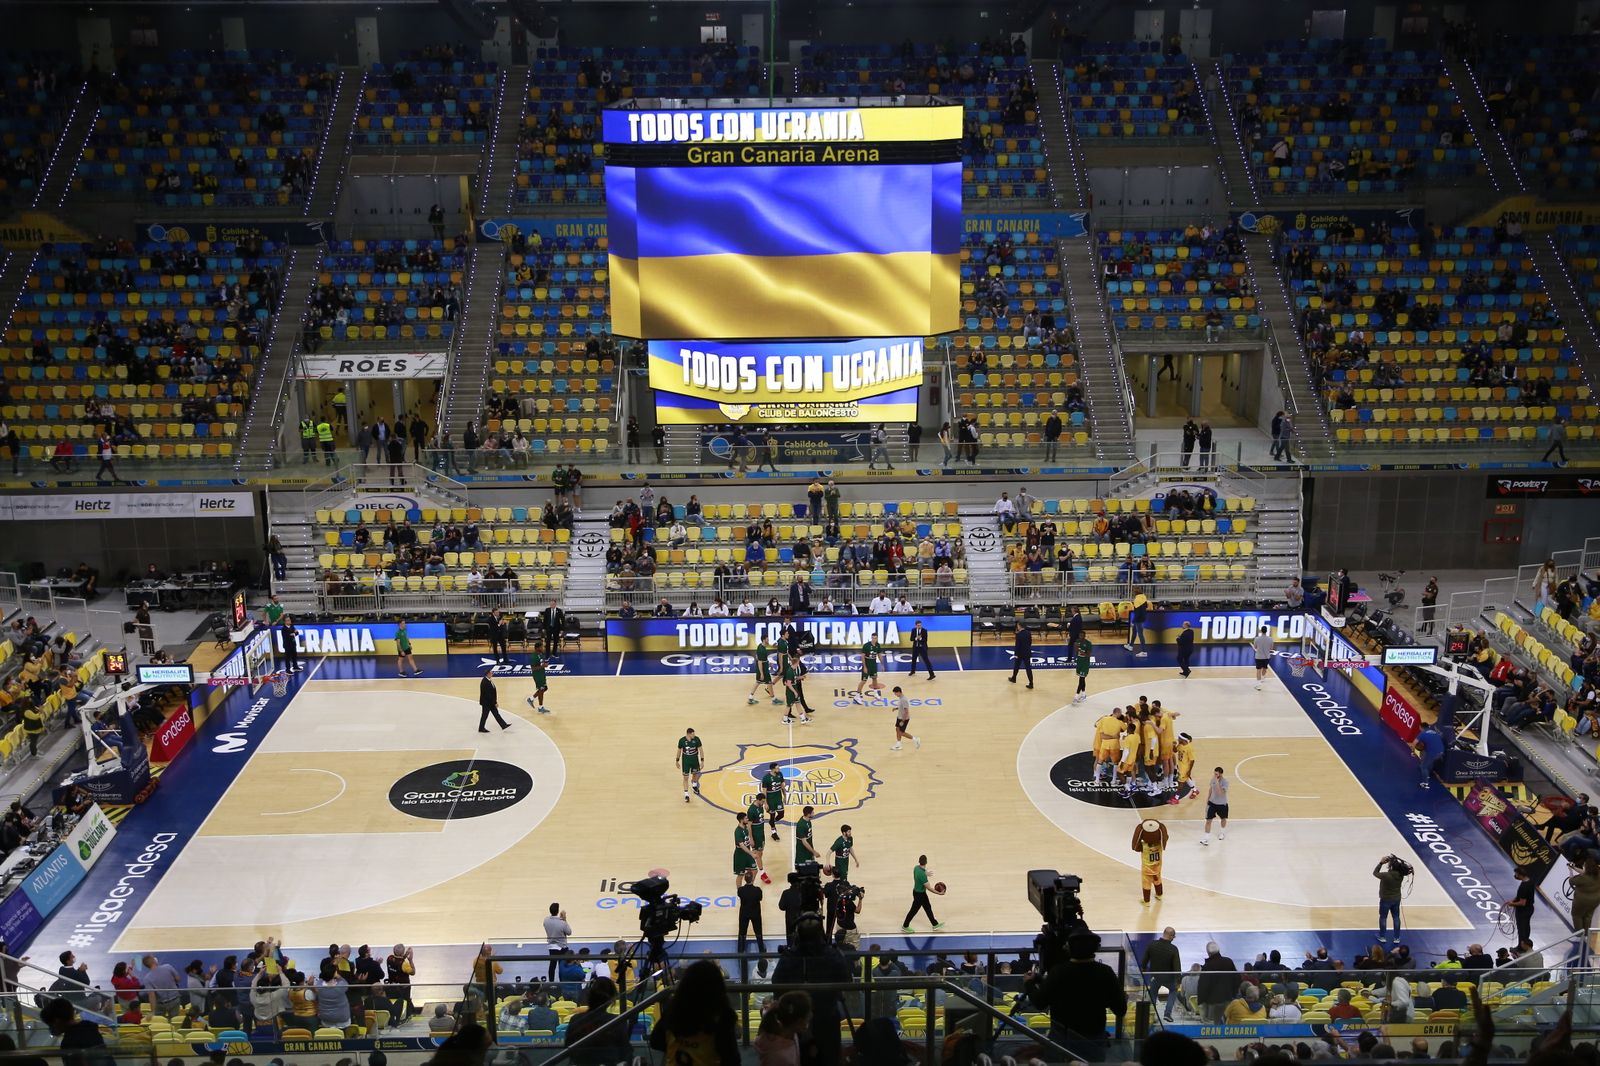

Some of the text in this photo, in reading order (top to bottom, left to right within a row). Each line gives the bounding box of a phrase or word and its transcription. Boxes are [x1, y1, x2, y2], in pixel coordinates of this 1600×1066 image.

[628, 111, 864, 142] TODOS CON UCRANIA
[687, 146, 880, 164] Gran Canaria Arena
[1535, 210, 1583, 224] CANARIA
[555, 223, 582, 237] GRAN
[965, 219, 1041, 232] GRAN CANARIA
[0, 228, 44, 241] ANARIA
[339, 359, 408, 373] ROES
[679, 340, 924, 393] TODOS CON UCRANIA
[758, 409, 859, 418] CLUB DE BALONCESTO
[784, 440, 829, 448] Cabildo de
[784, 448, 838, 456] Gran Canaria
[75, 500, 111, 510] Hertz
[200, 499, 235, 508] Hertz
[676, 622, 749, 648] TODOS
[1451, 642, 1463, 650] 24
[109, 662, 122, 671] 24
[660, 653, 755, 667] Gran
[233, 697, 270, 729] Movistar
[1302, 683, 1363, 736] endesa
[1385, 694, 1415, 729] endesa
[161, 711, 191, 746] endesa
[403, 787, 517, 801] Gran Canaria
[1149, 852, 1160, 862] 00
[32, 854, 69, 893] ATLANTIS
[1405, 813, 1512, 925] #ligaendesa
[67, 832, 178, 948] #ligaendesa
[600, 878, 639, 895] lig
[1200, 1026, 1258, 1035] GRAN CANARIA
[1423, 1025, 1444, 1034] GRAN
[284, 1041, 343, 1051] GRAN CANARIA
